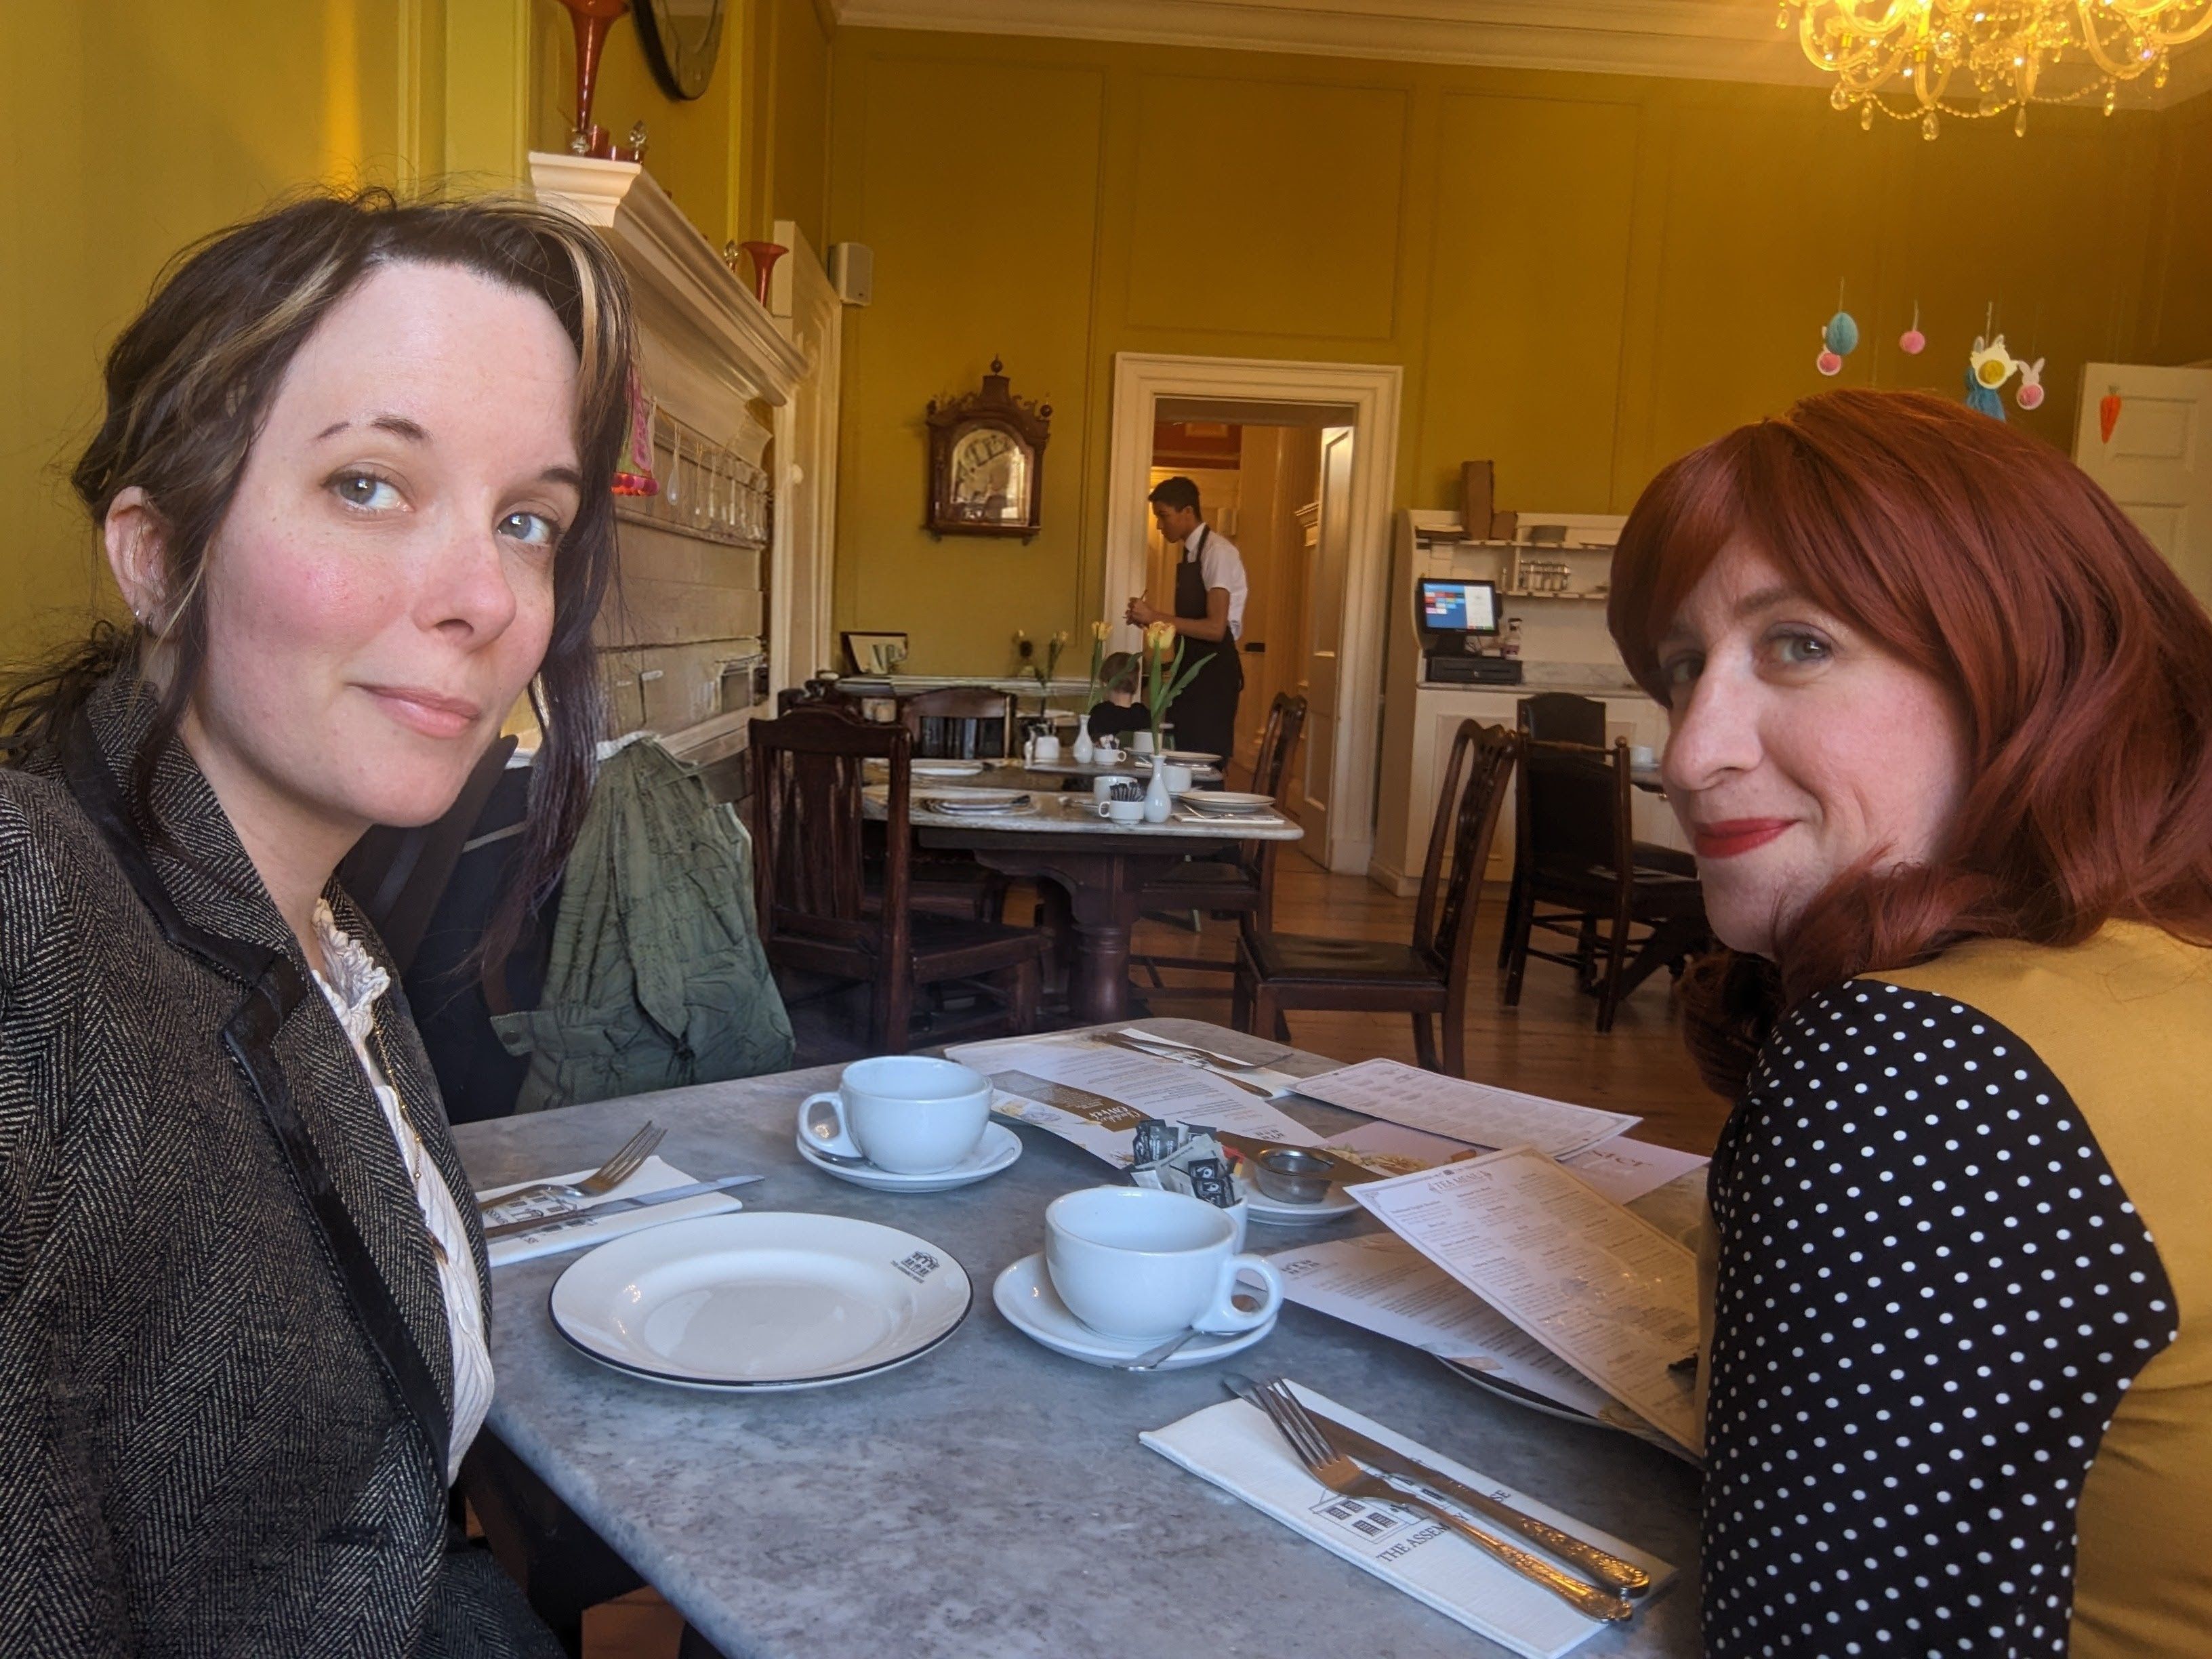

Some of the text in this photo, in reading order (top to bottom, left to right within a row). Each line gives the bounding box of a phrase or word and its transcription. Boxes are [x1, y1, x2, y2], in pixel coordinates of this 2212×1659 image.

[1433, 1172, 1483, 1190] TEA MENU
[1376, 1542, 1410, 1562] THE
